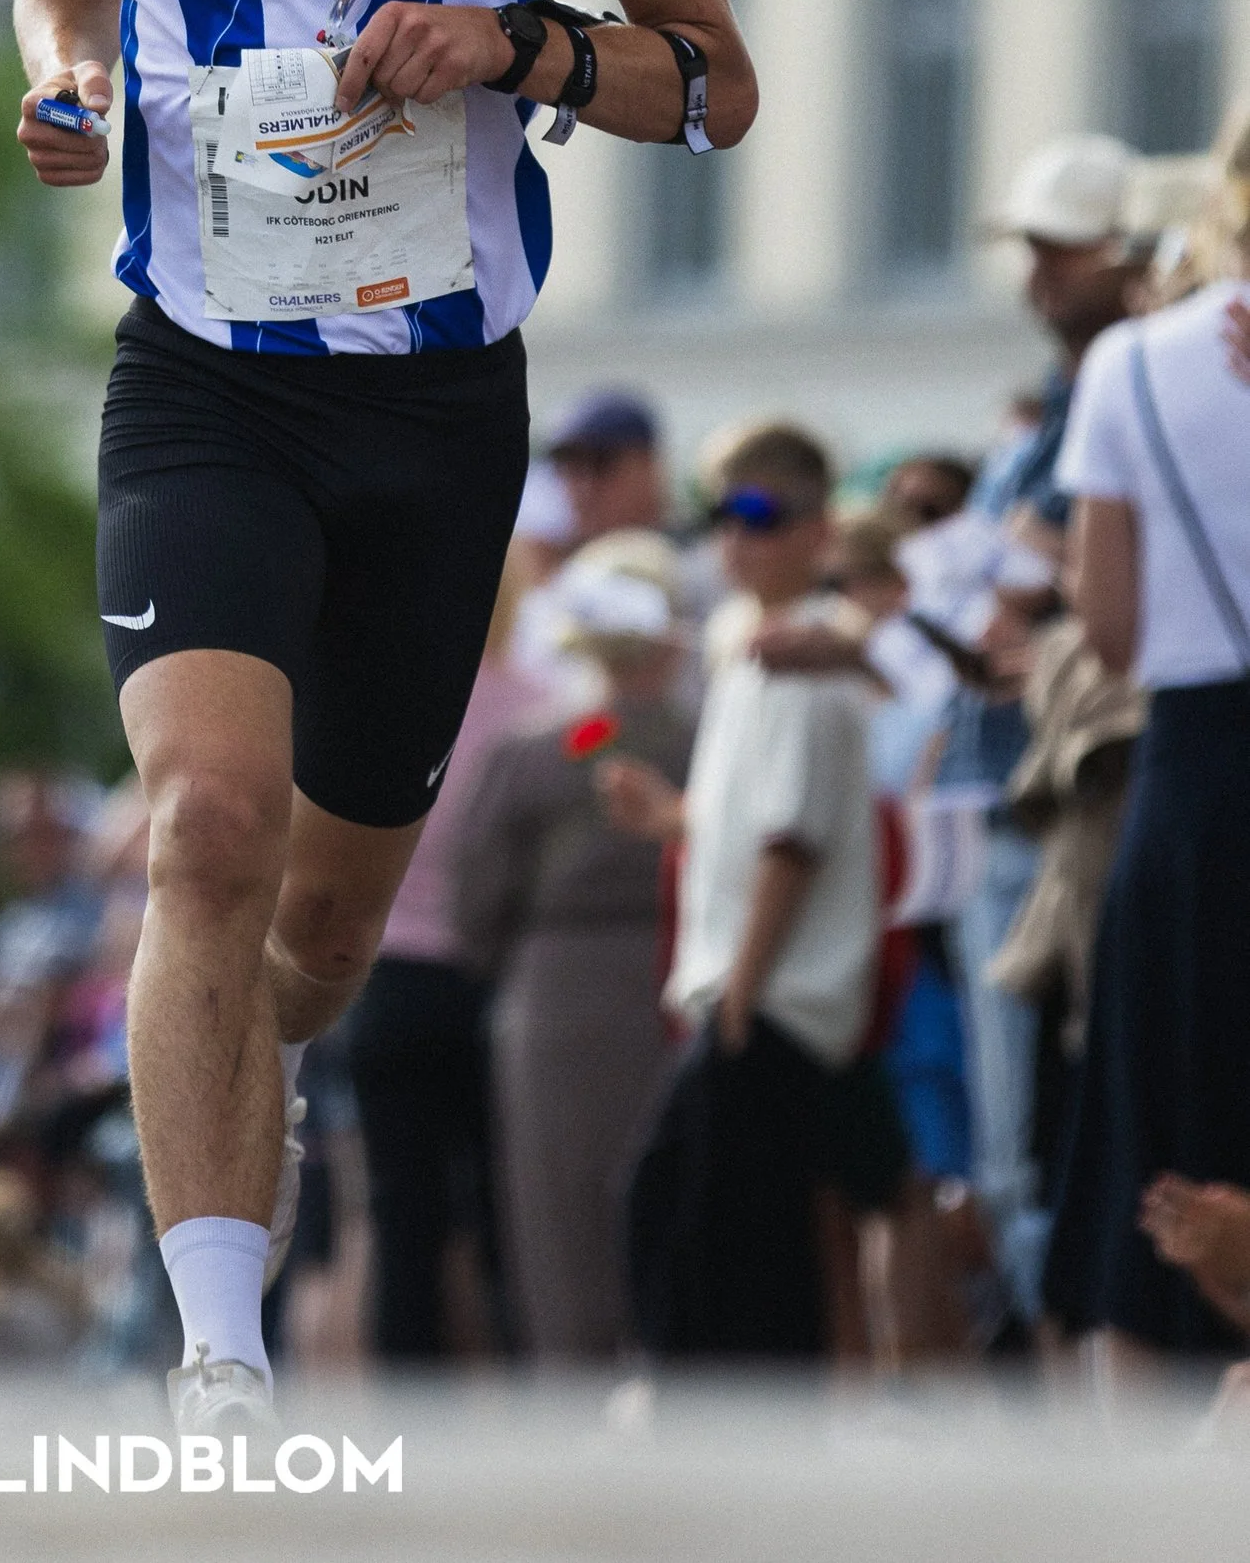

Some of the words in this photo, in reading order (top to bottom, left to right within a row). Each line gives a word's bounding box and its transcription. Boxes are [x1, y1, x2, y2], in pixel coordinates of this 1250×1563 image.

[259, 109, 342, 134] CHALMERS
[340, 109, 396, 155] CHALMERS
[266, 216, 281, 225] IFK
[284, 215, 336, 227] GÖTEBORG
[338, 203, 400, 224] ORIENTERING
[315, 235, 333, 245] H21
[336, 231, 354, 242] ELIT
[269, 293, 341, 306] CHALMERS
